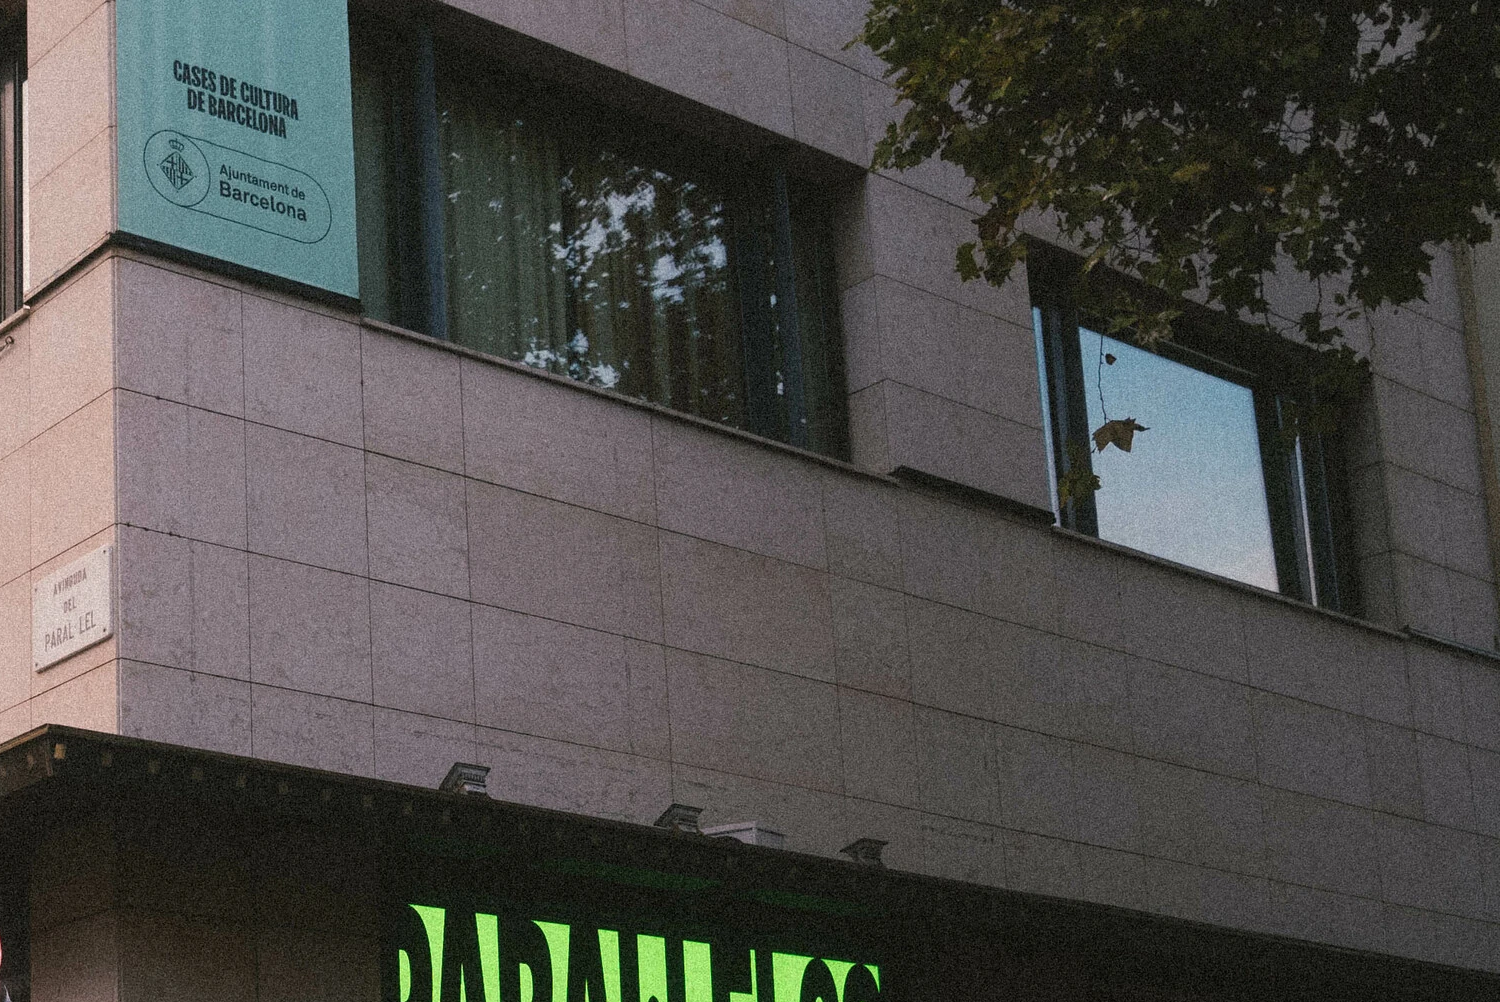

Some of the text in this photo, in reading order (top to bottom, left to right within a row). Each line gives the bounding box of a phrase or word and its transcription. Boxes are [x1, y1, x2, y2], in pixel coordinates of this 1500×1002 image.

[173, 59, 299, 121] CASES DE CULTURA
[187, 88, 287, 139] DE BARCELONA
[219, 164, 306, 201] Ajuntament de
[219, 180, 307, 222] Barcelona
[53, 567, 87, 596] AVINGUDA
[63, 597, 77, 613] DEL
